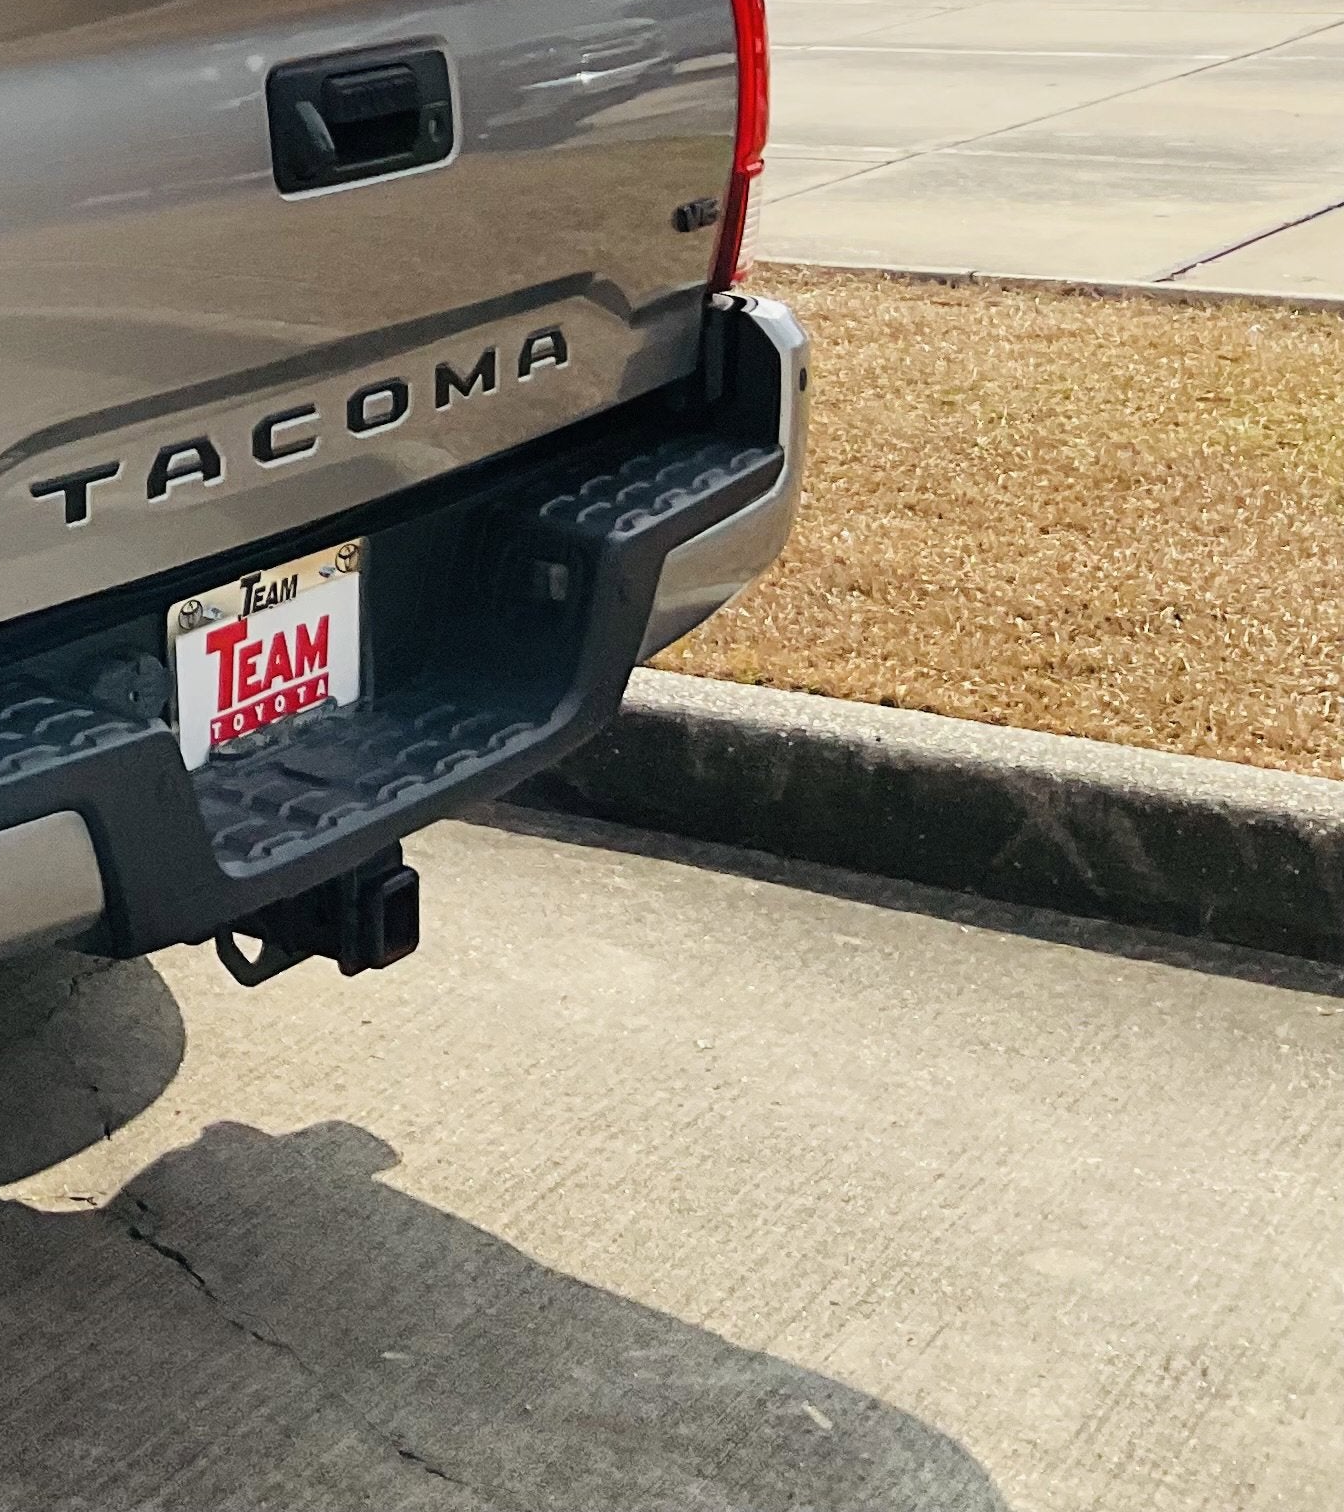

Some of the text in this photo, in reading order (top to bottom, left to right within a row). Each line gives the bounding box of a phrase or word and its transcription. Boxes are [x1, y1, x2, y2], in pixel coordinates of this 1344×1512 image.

[29, 324, 571, 527] TACOMA
[238, 570, 299, 619] TEAM
[206, 614, 330, 712] TEAM
[212, 679, 327, 740] TOYOTA
